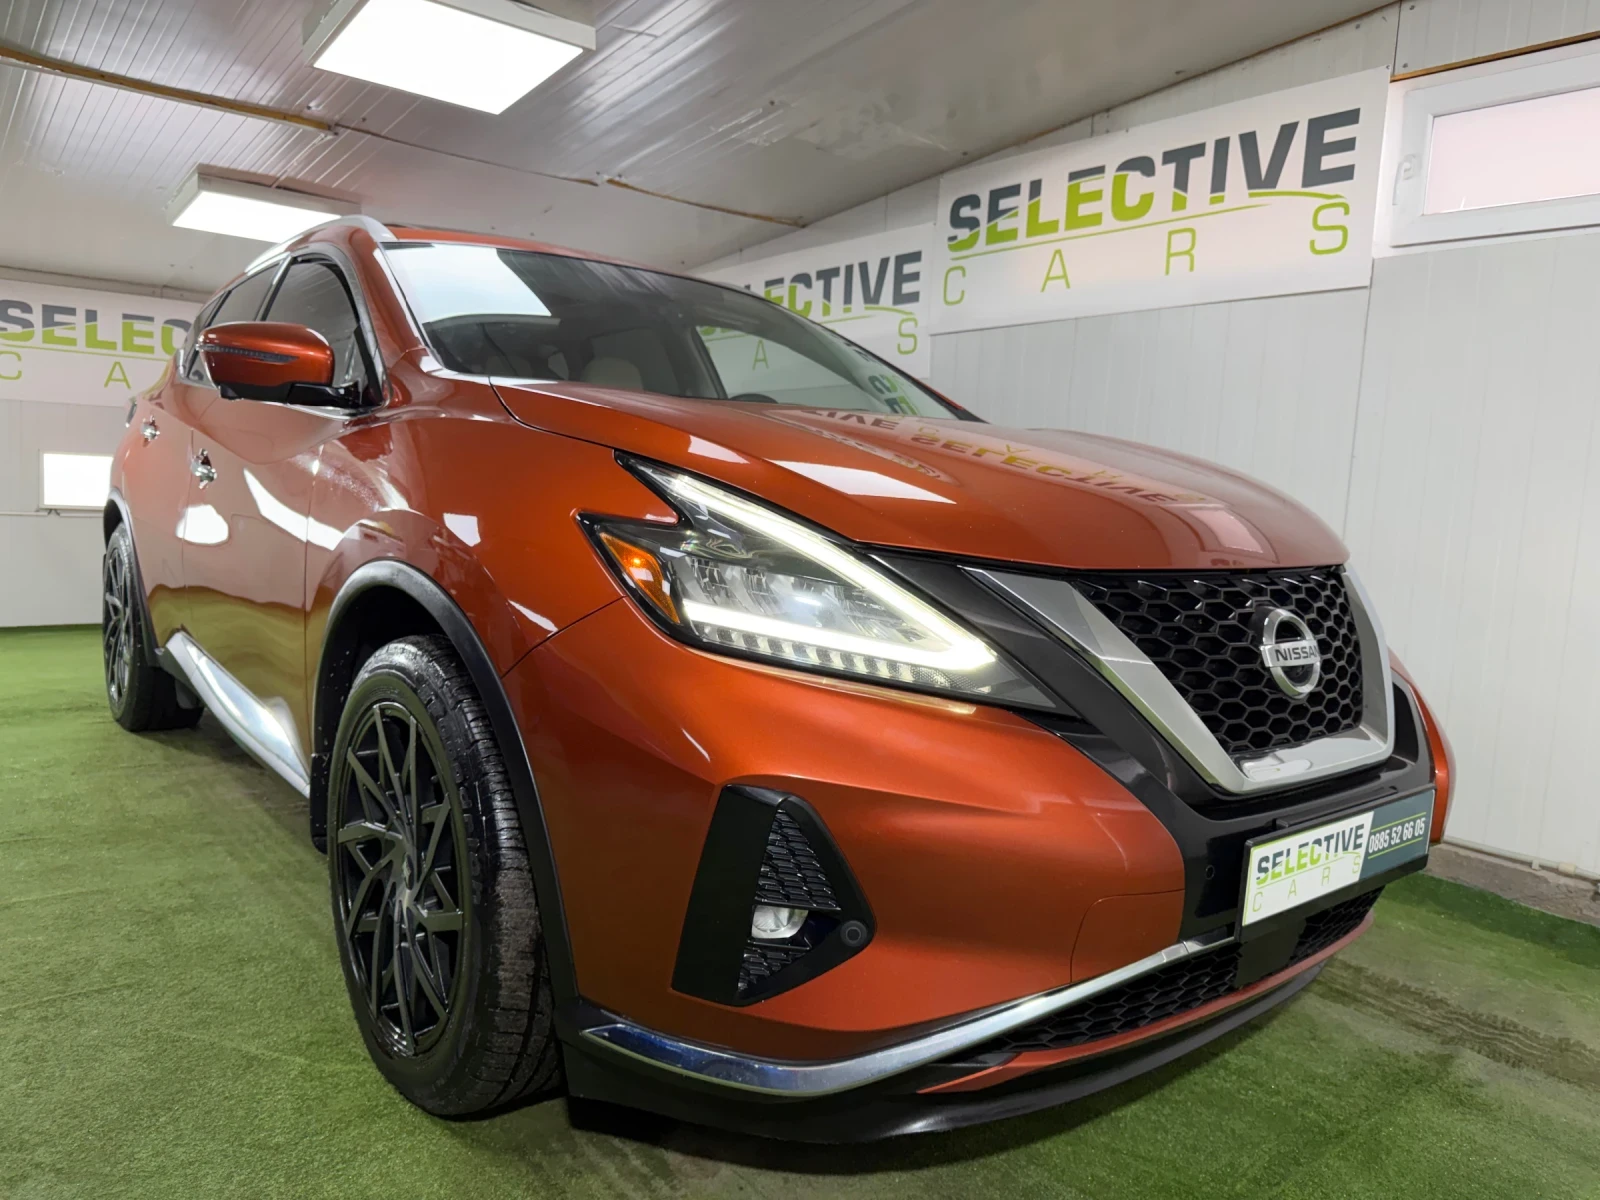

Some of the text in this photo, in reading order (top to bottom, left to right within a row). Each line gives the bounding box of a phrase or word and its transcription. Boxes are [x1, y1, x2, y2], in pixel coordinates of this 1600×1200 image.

[947, 107, 1361, 252] SELECTIVE
[943, 201, 1351, 306] CARS
[745, 250, 922, 320] ECTIVE
[0, 299, 193, 355] SELEC
[1257, 823, 1365, 885] SELECTIVE
[1368, 817, 1426, 854] 0885 52 66 05
[1252, 855, 1361, 912] CARS
